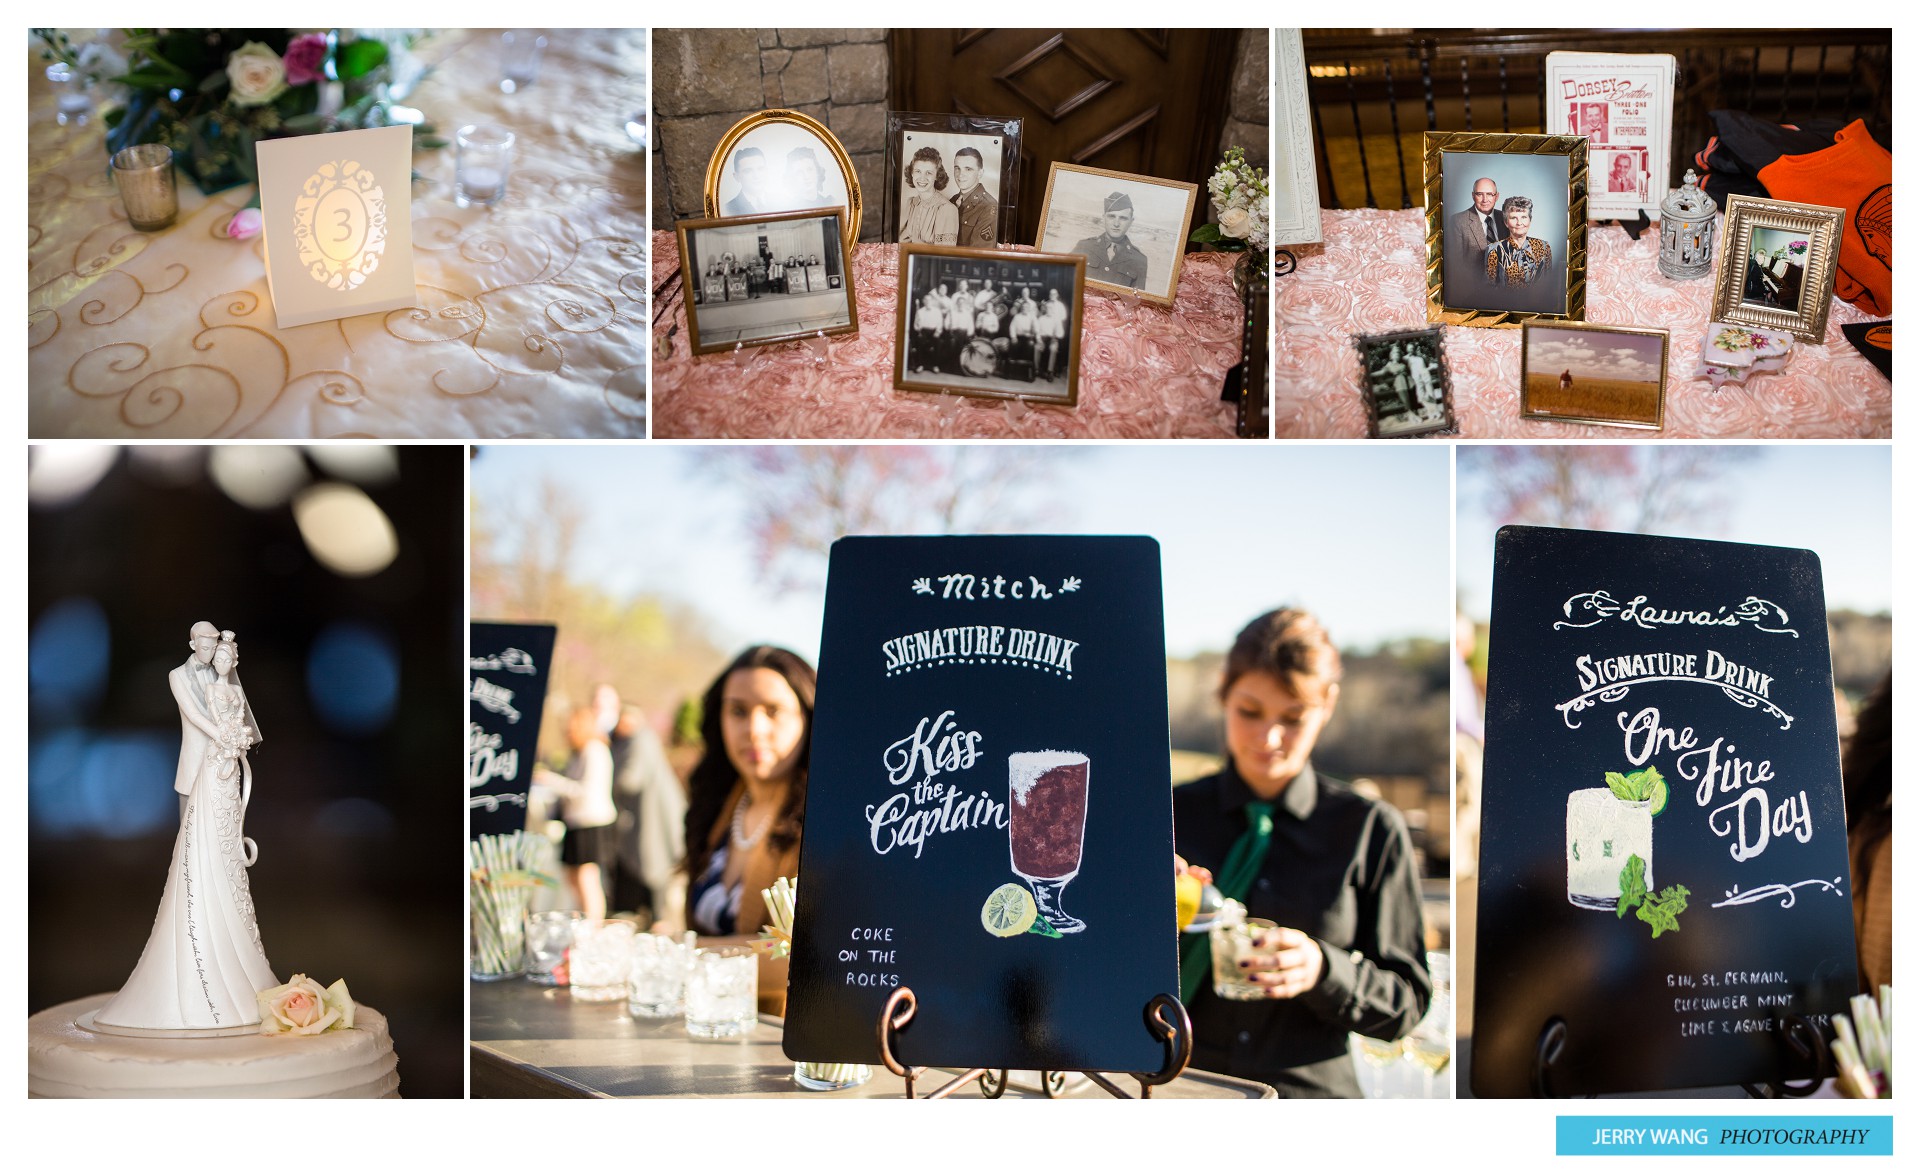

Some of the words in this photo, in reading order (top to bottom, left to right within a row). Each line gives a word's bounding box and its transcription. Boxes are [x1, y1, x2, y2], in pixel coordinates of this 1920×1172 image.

[1561, 77, 1616, 100] DORSEY
[1604, 80, 1654, 101] Brothers
[333, 208, 352, 242] 3
[945, 263, 1040, 279] LINCOLN
[937, 573, 1053, 600] Mitch
[1620, 595, 1740, 629] Laura's
[882, 625, 1005, 670] SIGNATURE
[1006, 628, 1080, 672] DRINK
[1575, 653, 1697, 691] SIGNATURE
[1704, 649, 1774, 699] DRINK
[883, 710, 984, 785] Kiss
[1617, 707, 1699, 766] One
[1677, 737, 1775, 806] Fine
[911, 775, 944, 805] the
[865, 785, 1009, 859] Captain
[1709, 787, 1813, 863] Day
[851, 927, 894, 941] COKE
[838, 949, 858, 962] ON
[867, 949, 897, 963] THE
[846, 972, 900, 987] ROCKS
[1674, 995, 1749, 1013] CUCUMBER
[1757, 993, 1794, 1008] MINT
[1681, 1020, 1716, 1037] LIME
[1734, 1018, 1773, 1034] AGAVE
